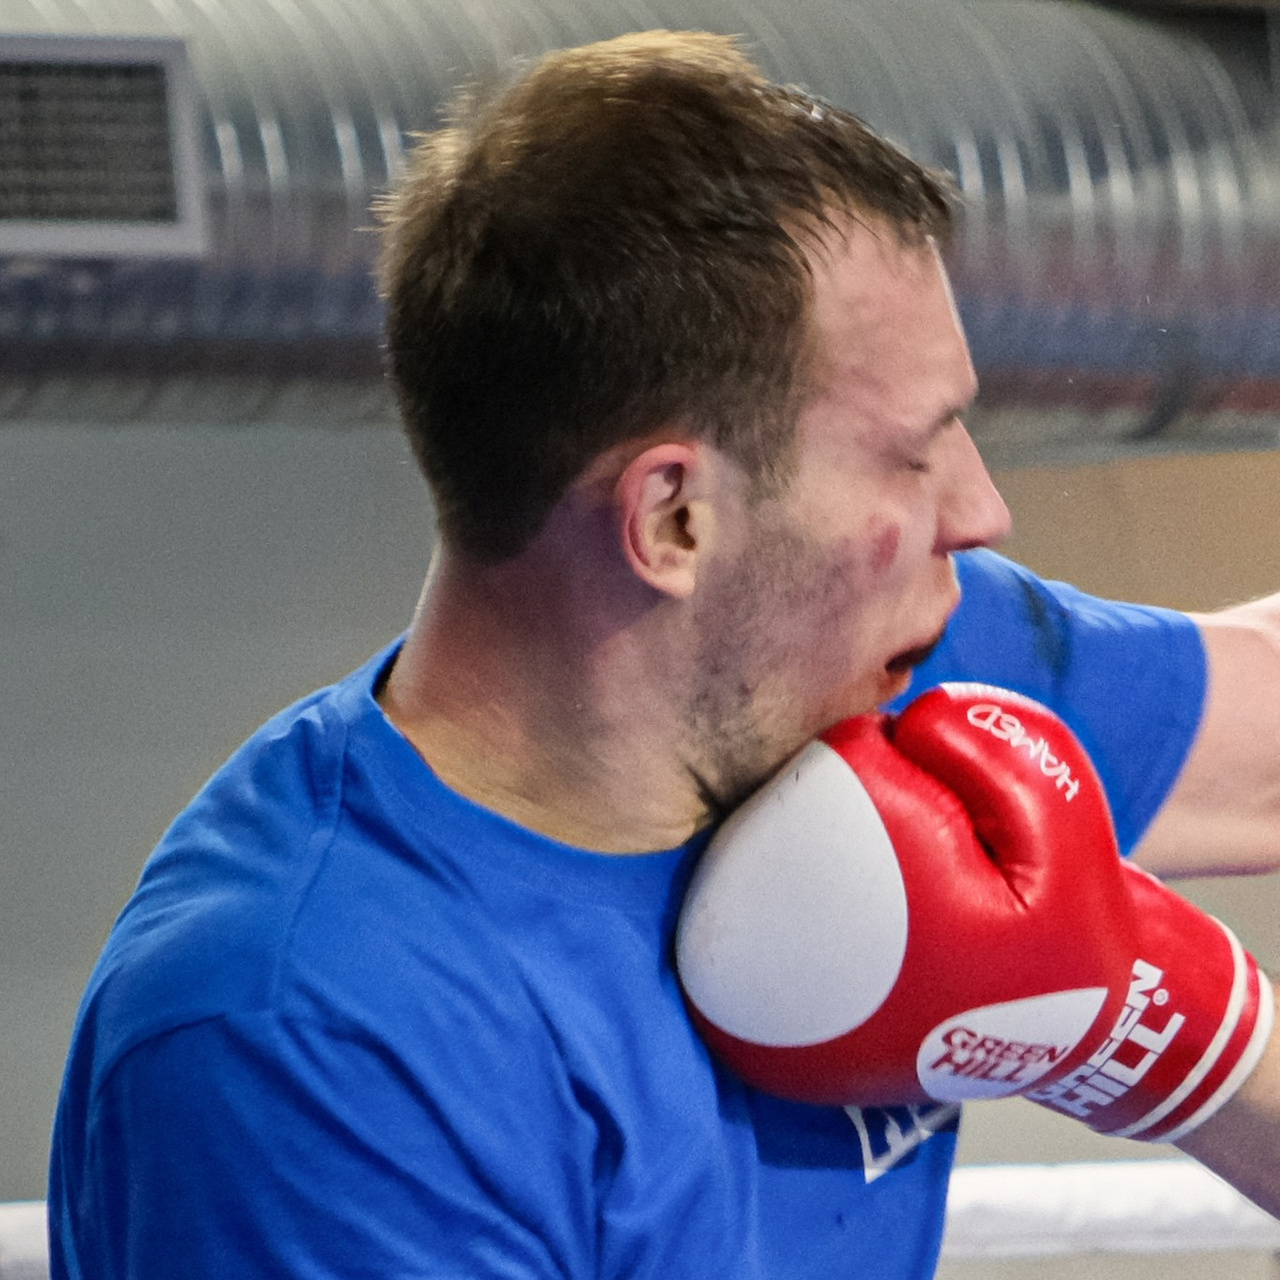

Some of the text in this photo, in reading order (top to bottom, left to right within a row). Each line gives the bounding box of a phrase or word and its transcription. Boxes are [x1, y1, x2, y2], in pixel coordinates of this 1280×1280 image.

[966, 704, 1080, 803] HAMED
[941, 1026, 1070, 1065] GREEN
[930, 1048, 1029, 1083] HILL
